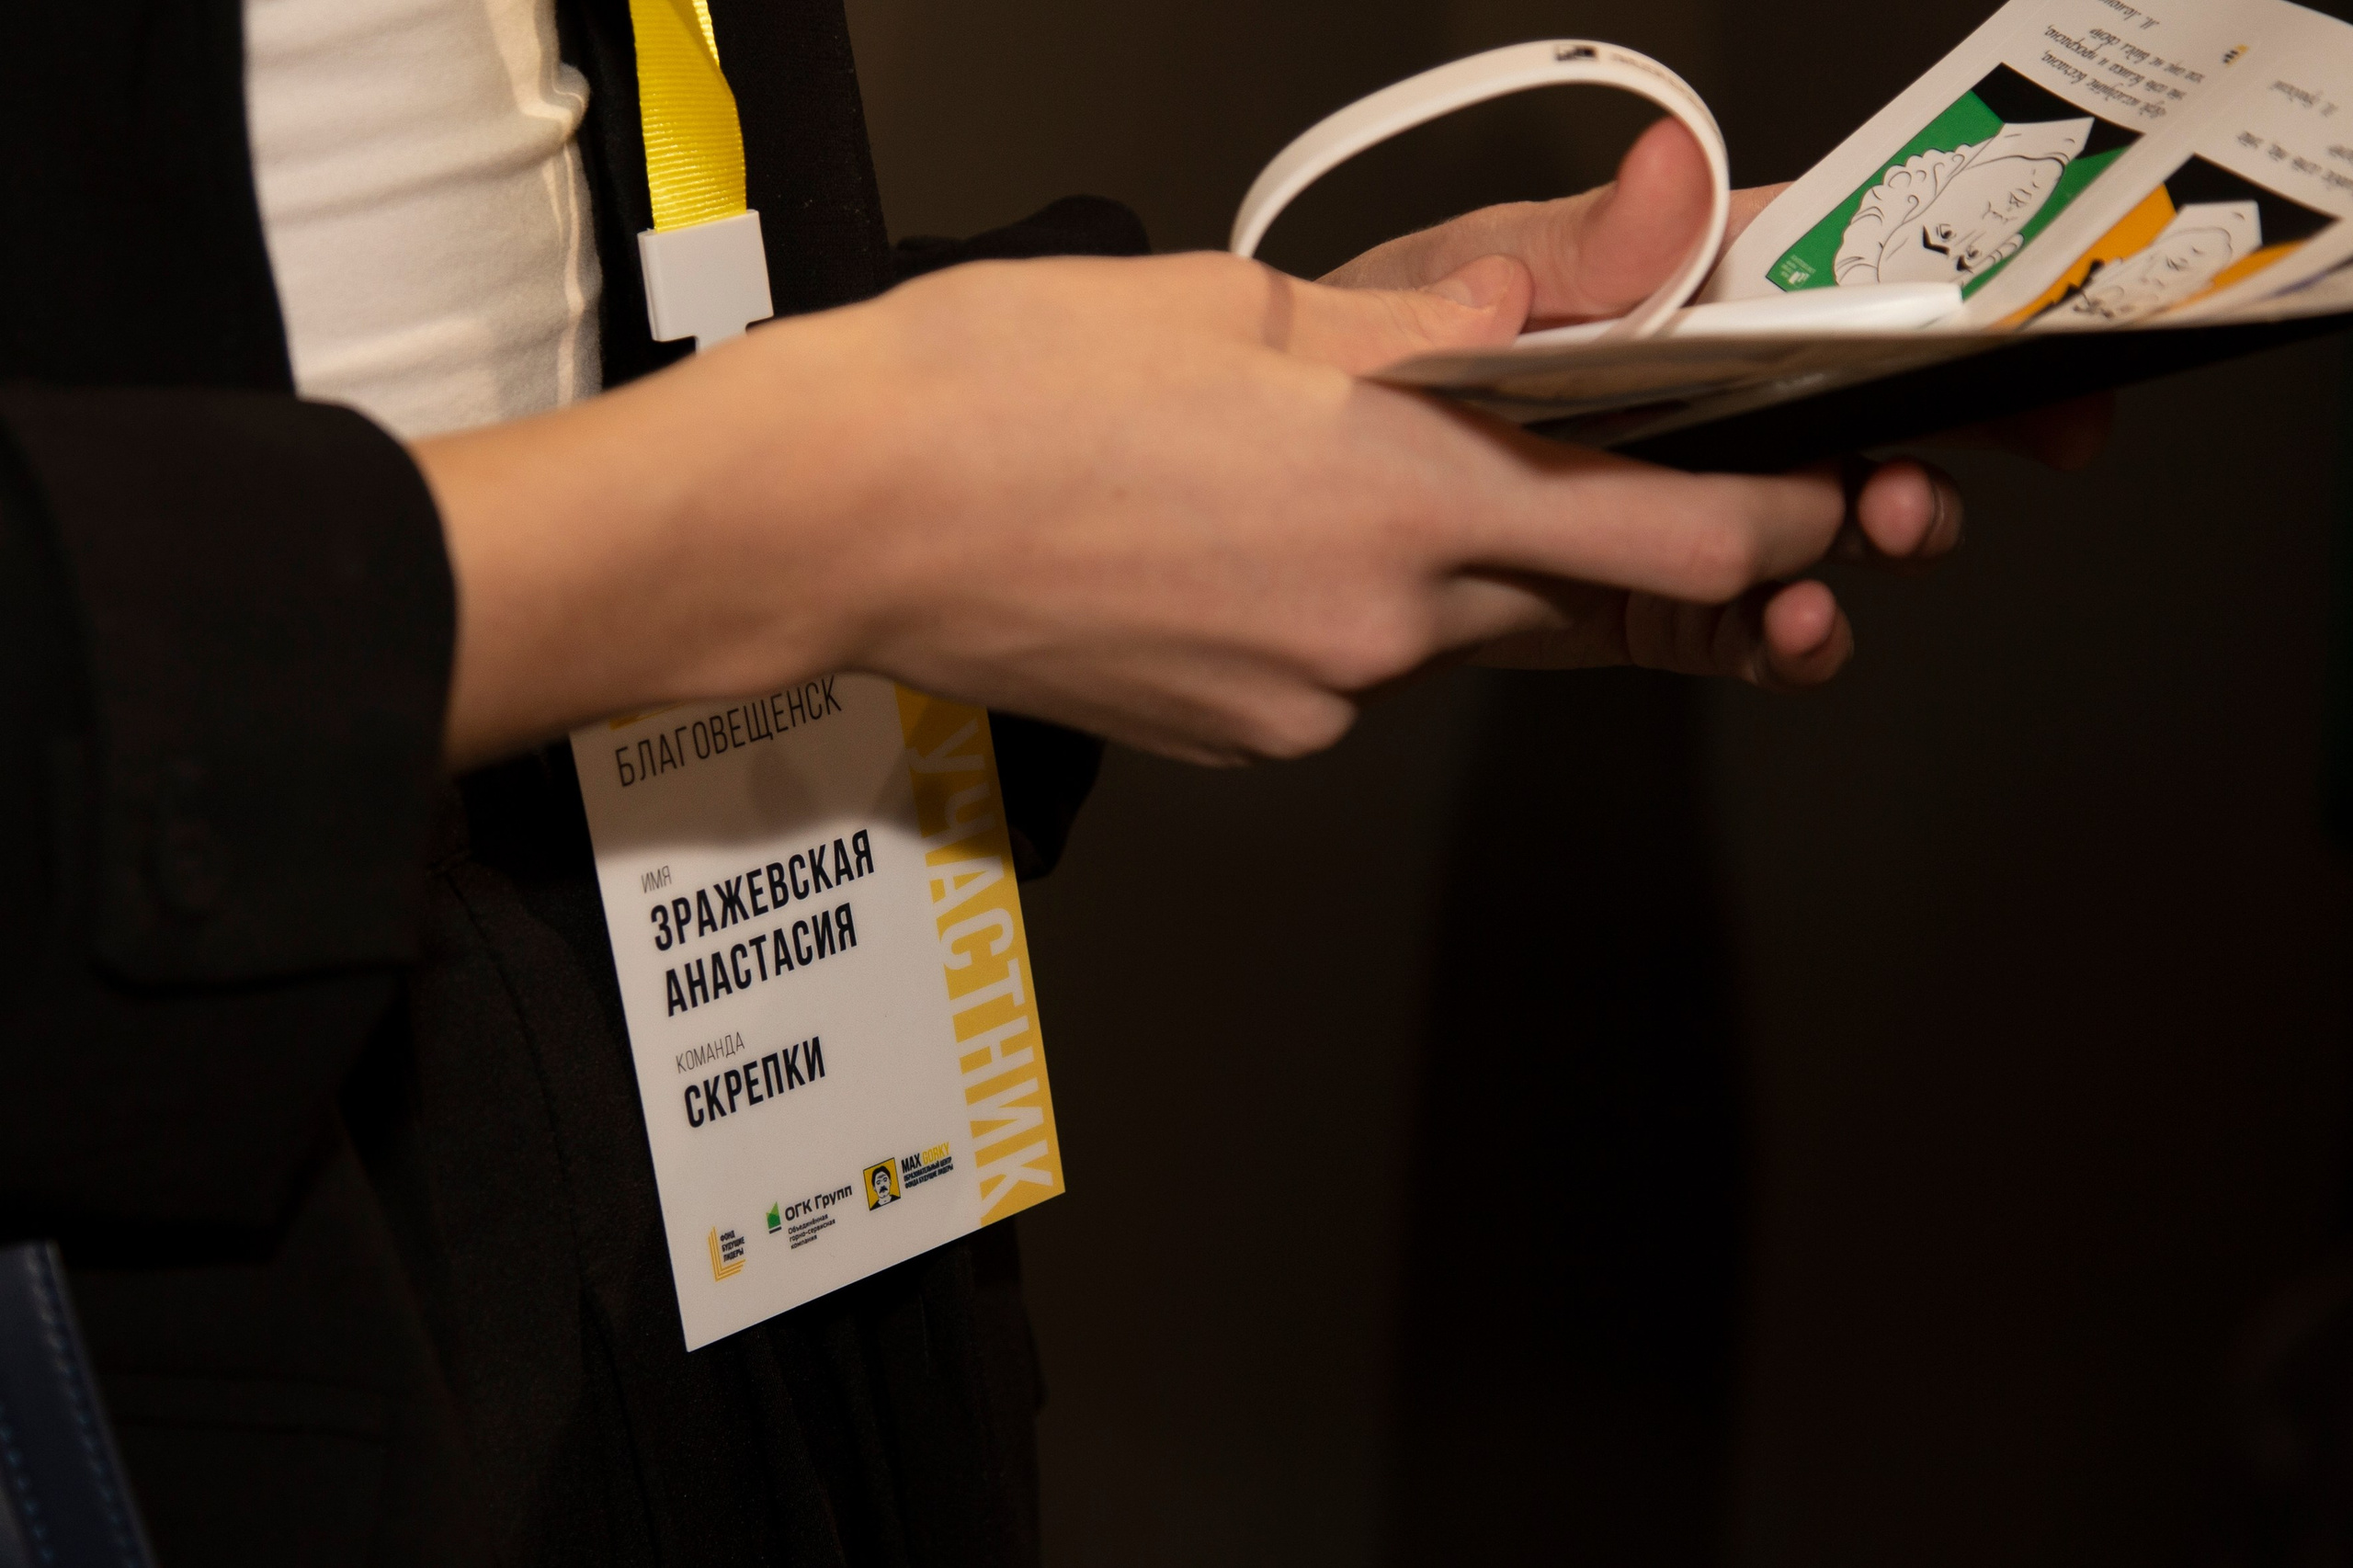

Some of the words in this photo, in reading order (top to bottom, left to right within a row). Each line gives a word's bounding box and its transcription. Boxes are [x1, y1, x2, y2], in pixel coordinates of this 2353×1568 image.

[615, 675, 842, 788] БЛАГОВЕЩЕНСК
[641, 865, 672, 893] ИМЯ
[651, 829, 875, 951] ЗРАЖЕВСКАЯ
[665, 902, 858, 1017] АНАСТАСИЯ
[908, 719, 1054, 1232] УЧАСТНИК
[676, 1030, 745, 1074] КОМАНДА
[683, 1036, 826, 1129] СКРЕПКИ
[901, 1153, 922, 1174] MAX
[922, 1142, 950, 1165] GORKY
[785, 1199, 813, 1221] ОГК
[814, 1185, 853, 1210] Групп
[720, 1230, 735, 1242] ФОНД
[790, 1219, 835, 1243] горно-сервисная
[790, 1234, 818, 1250] компания
